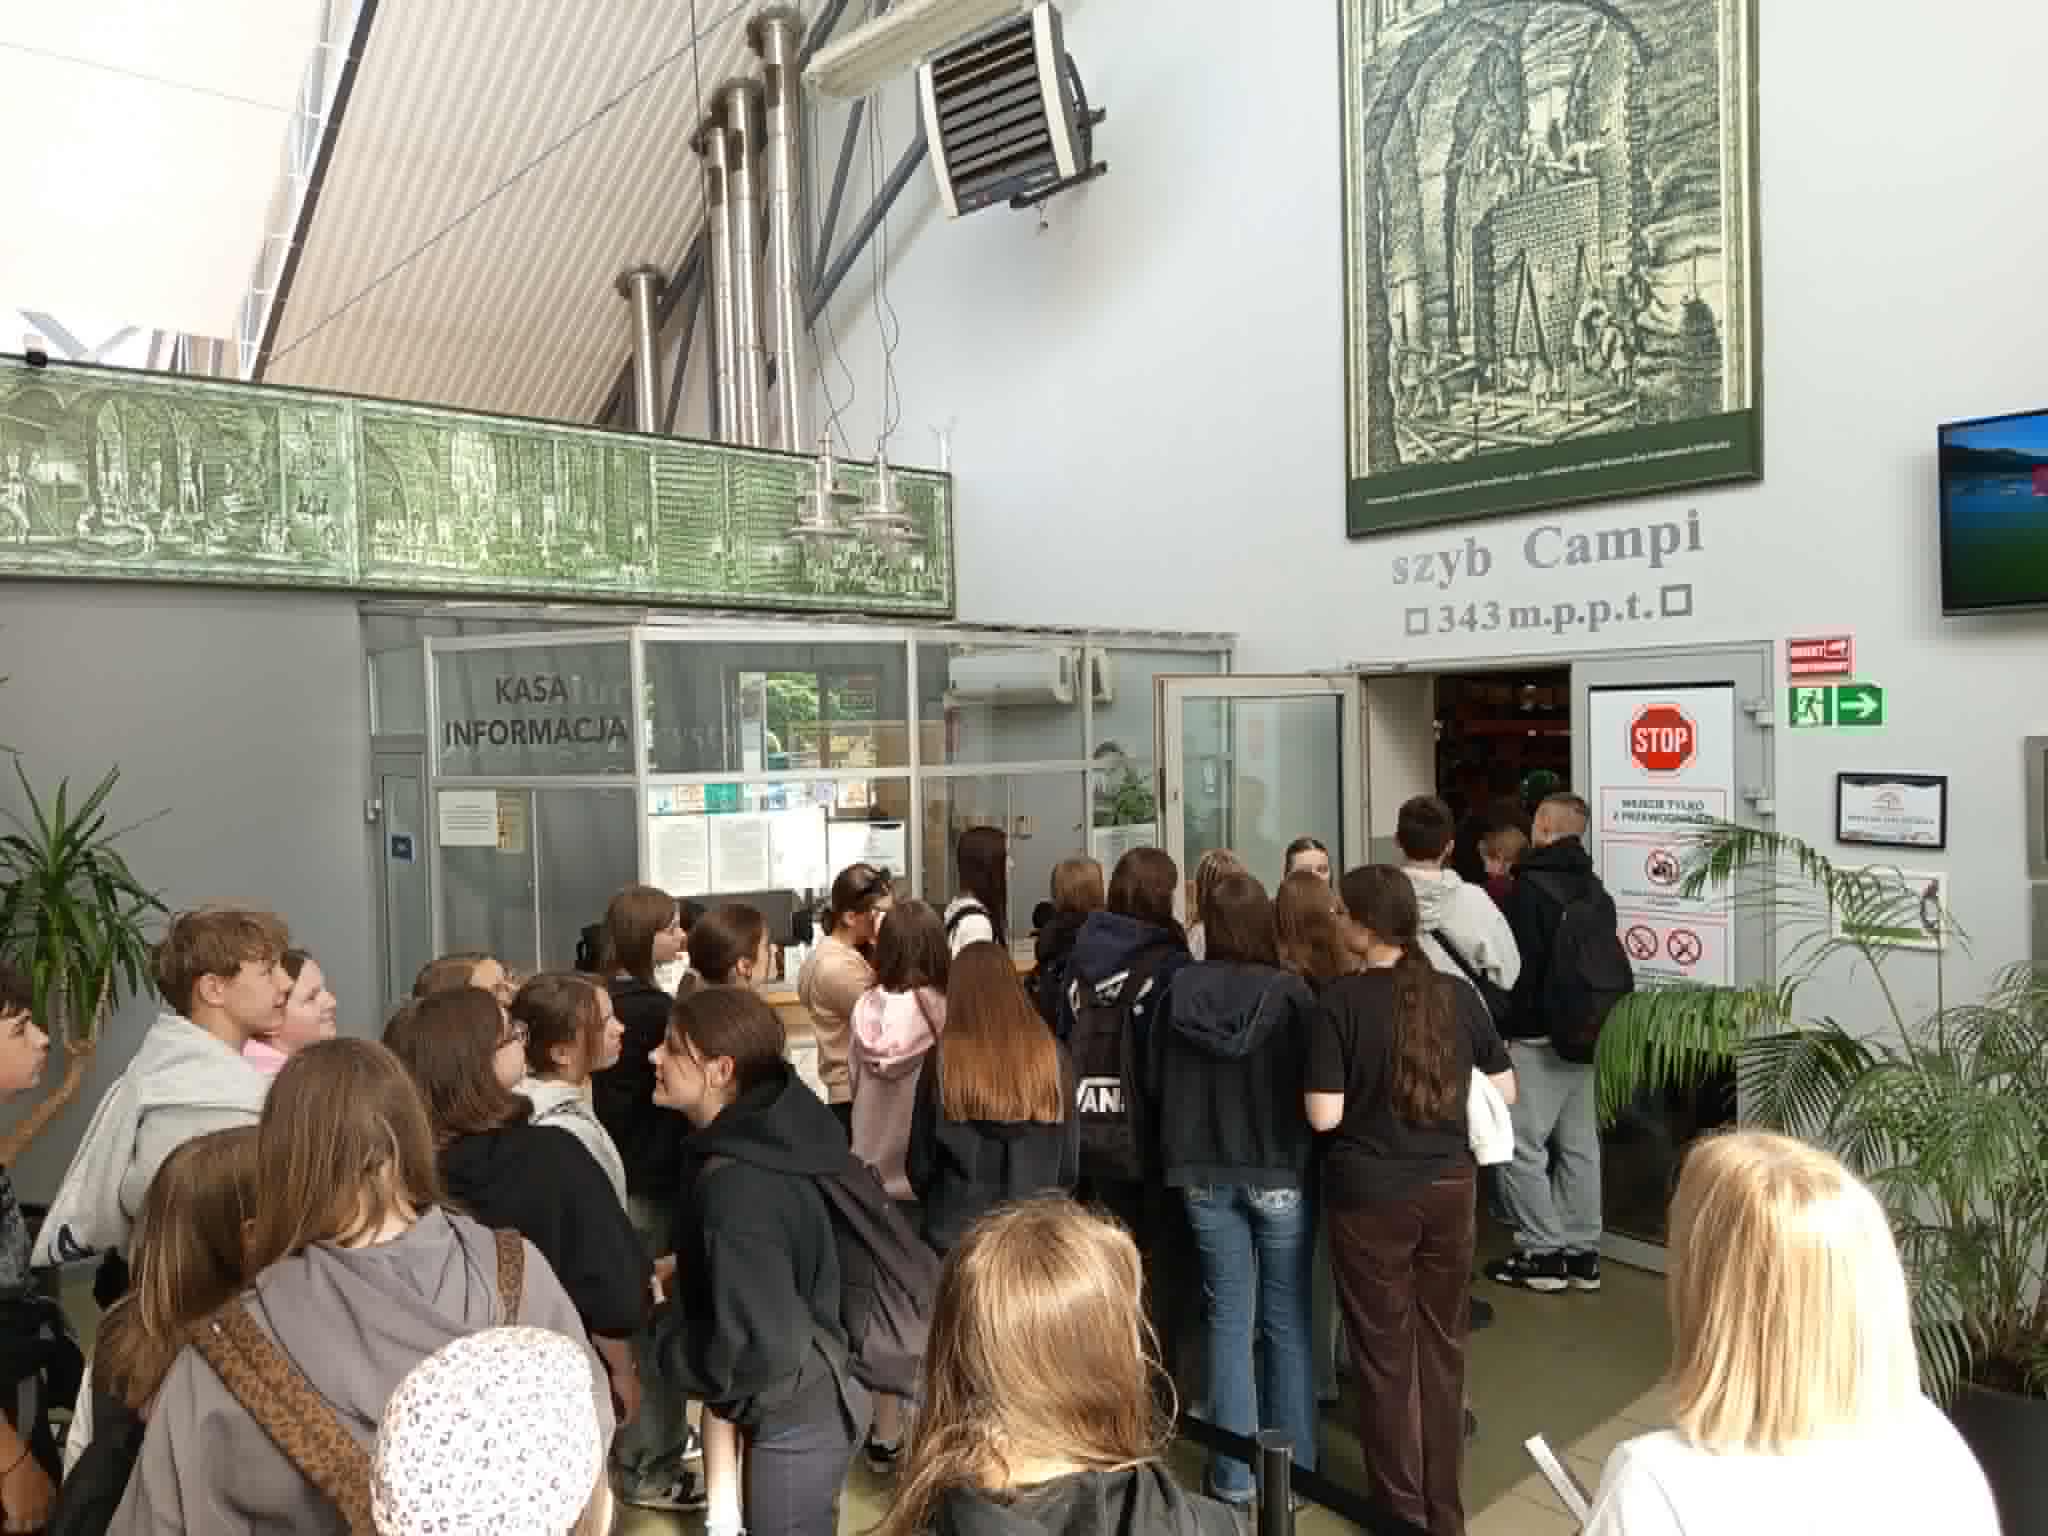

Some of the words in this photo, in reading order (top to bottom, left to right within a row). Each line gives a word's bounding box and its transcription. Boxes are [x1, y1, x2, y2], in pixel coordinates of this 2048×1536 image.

[1392, 536, 1492, 589] szyb
[1524, 508, 1705, 568] Campi
[495, 676, 568, 703] KASA
[445, 715, 628, 746] INFORMACJA
[1635, 727, 1688, 752] STOP
